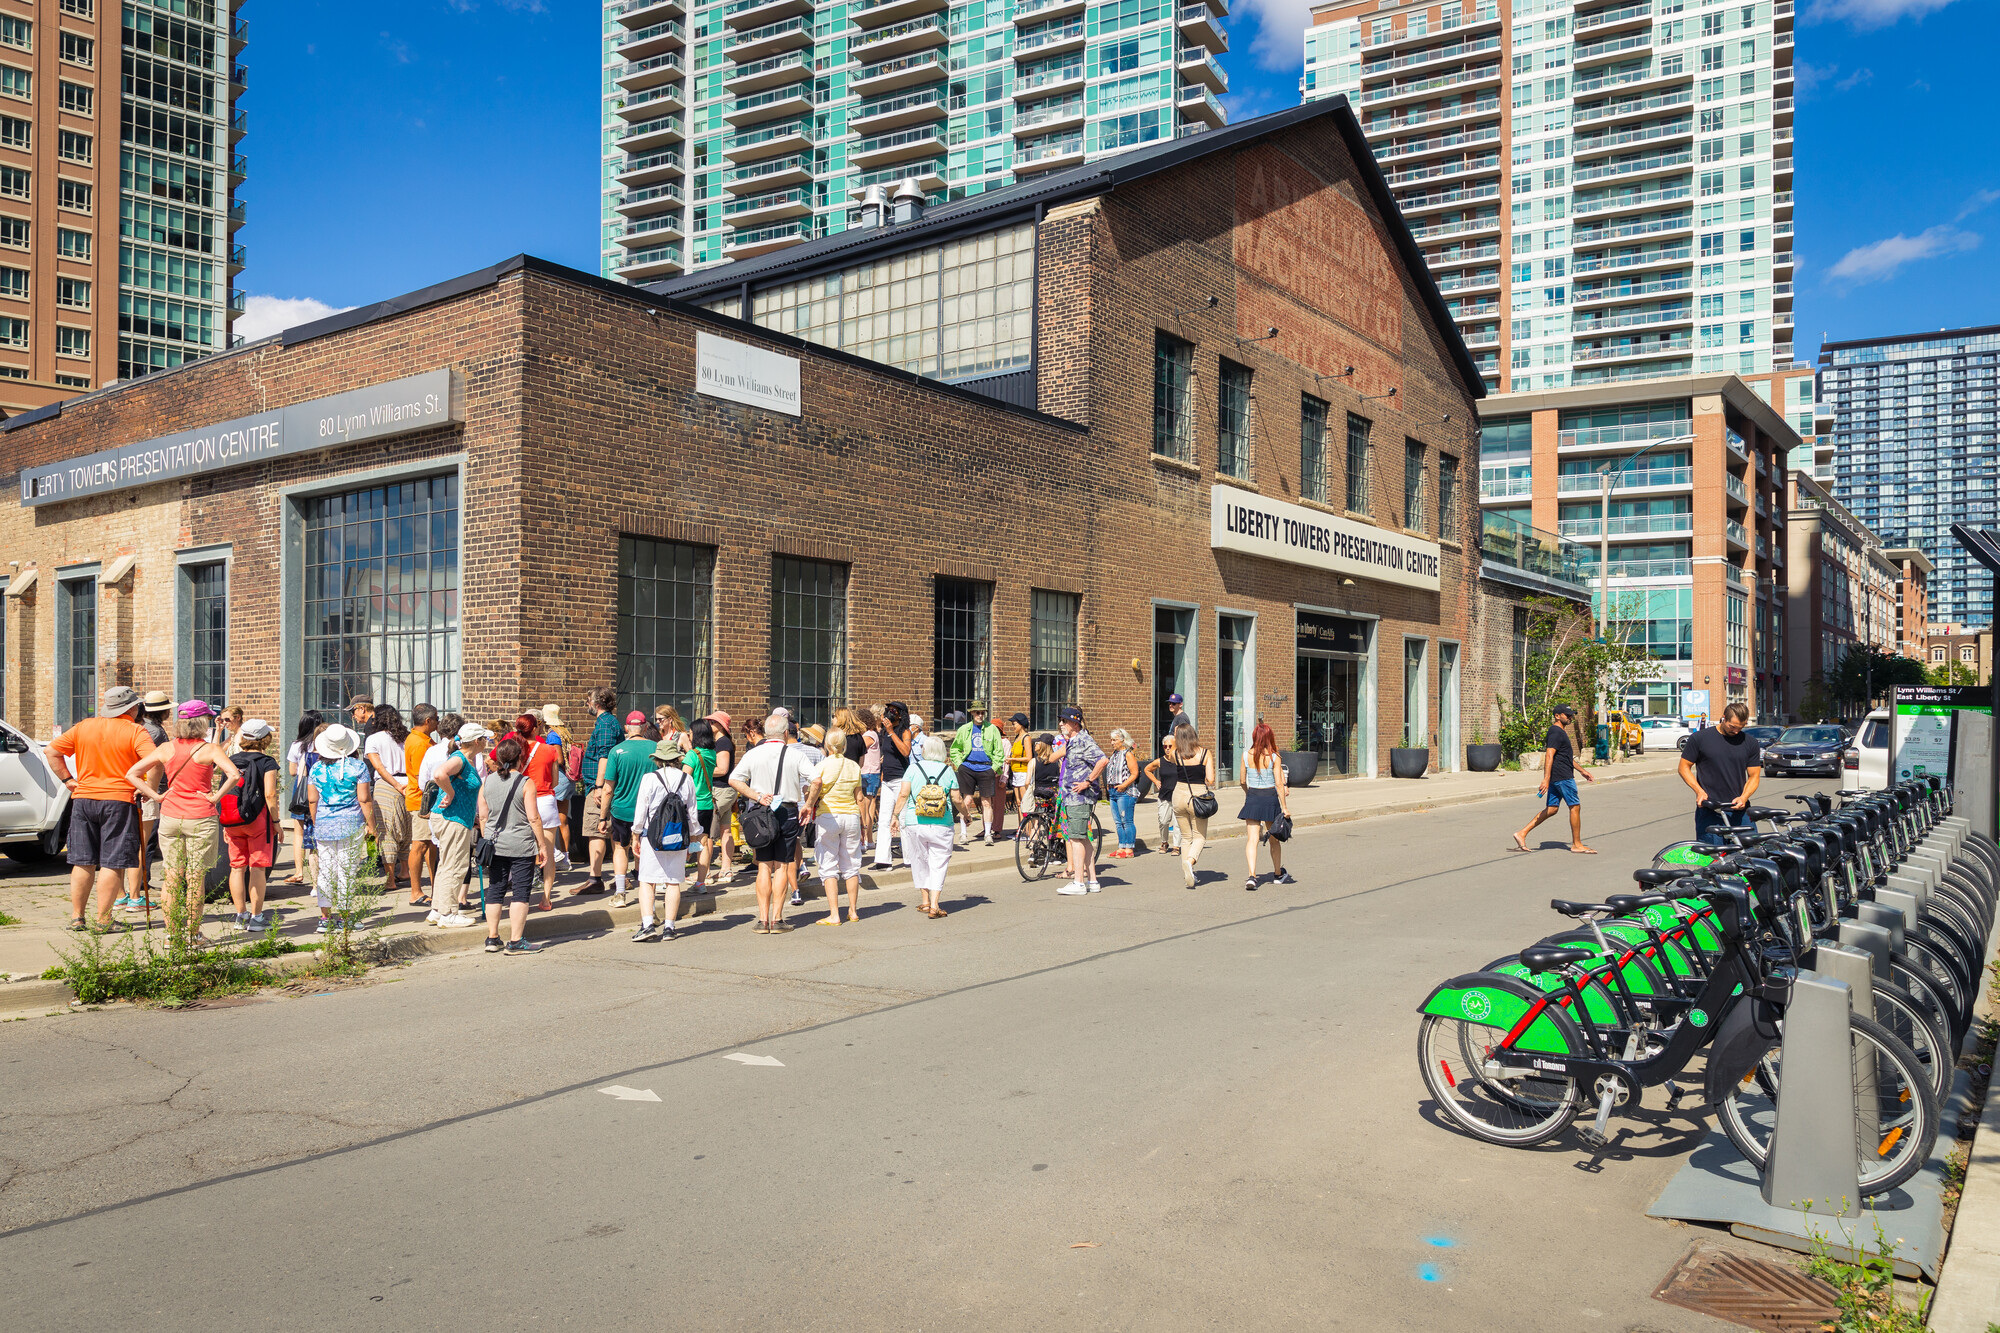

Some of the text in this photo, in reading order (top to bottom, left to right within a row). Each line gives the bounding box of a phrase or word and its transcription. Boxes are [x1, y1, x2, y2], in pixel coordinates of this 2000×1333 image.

[701, 365, 796, 402] 80 Lynn Williams Street
[319, 394, 442, 437] 80 Lynn Williams St.
[23, 422, 279, 500] LIBERTY TOWERS PRESENTATION CENTRE
[1227, 503, 1438, 578] LIBERTY TOWERS PRESENTATION CENTRE
[1311, 710, 1345, 723] EMPORIUM
[1541, 1059, 1566, 1072] TORONTO
